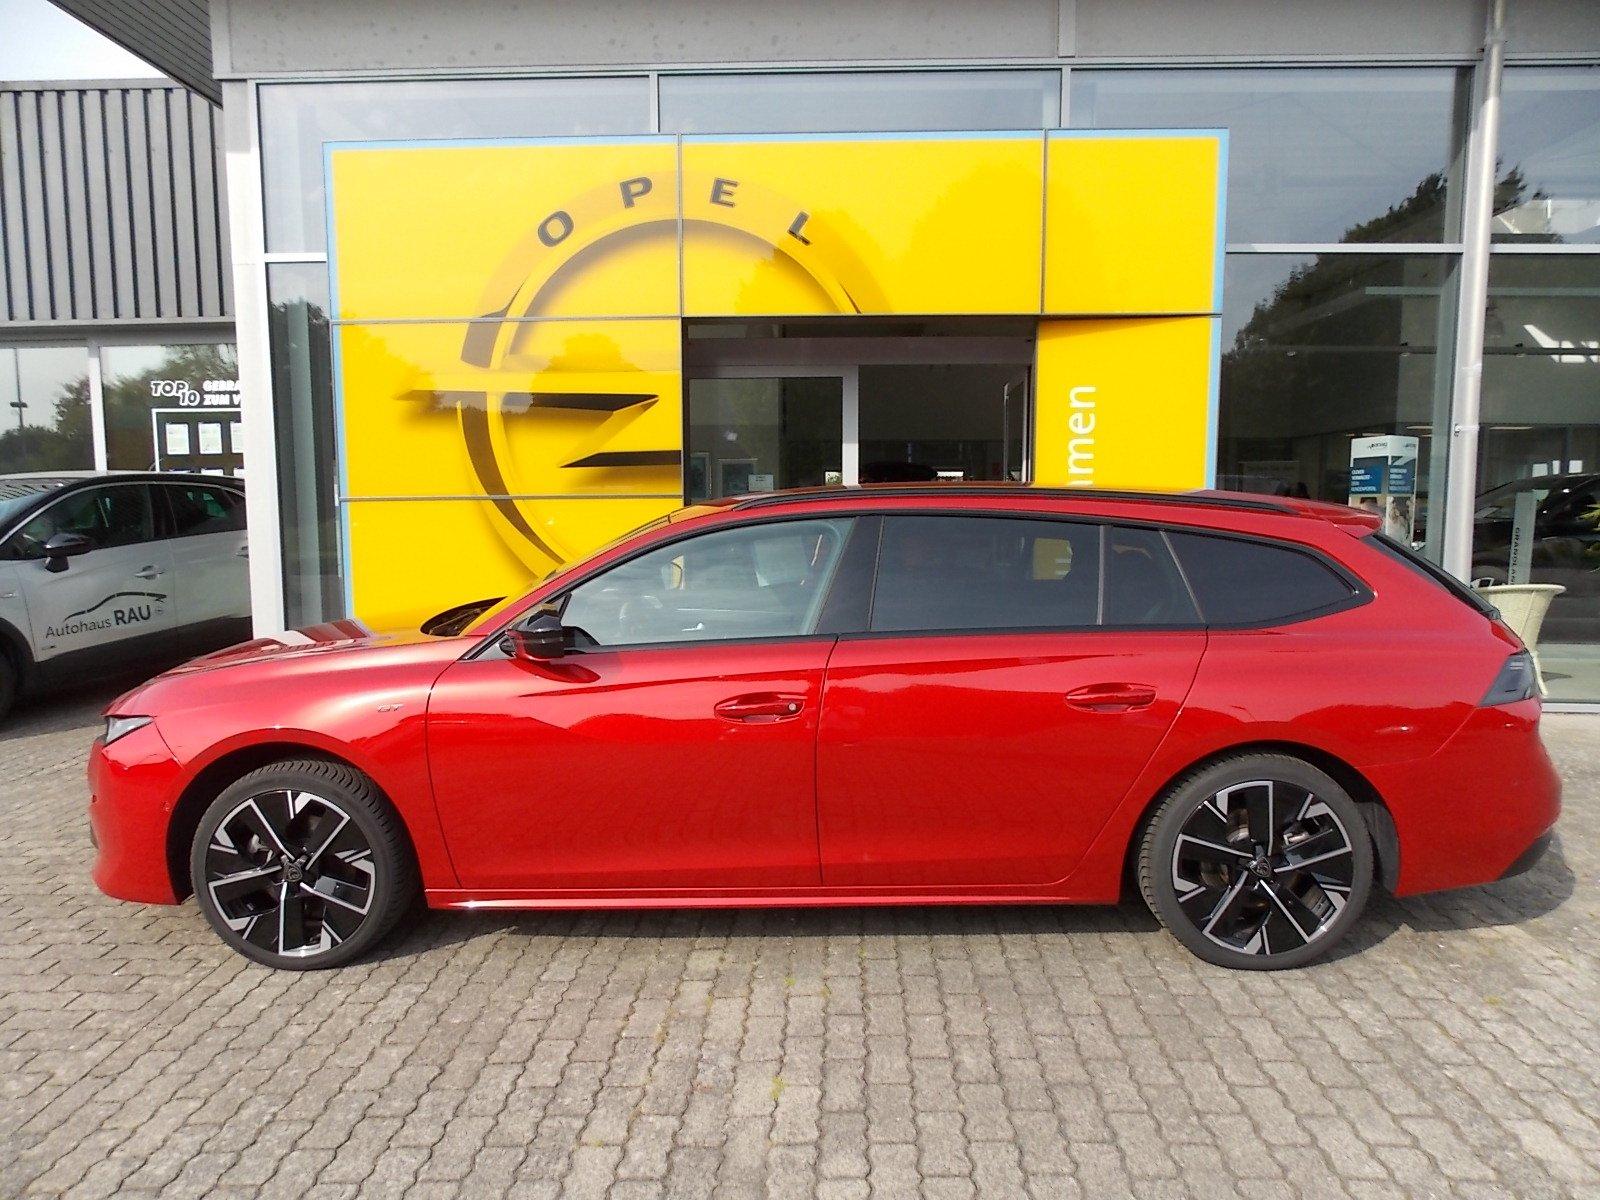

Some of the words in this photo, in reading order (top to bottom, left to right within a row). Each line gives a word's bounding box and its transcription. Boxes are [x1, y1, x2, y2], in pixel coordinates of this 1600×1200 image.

[537, 176, 813, 247] OPEL
[150, 380, 190, 397] TOP
[179, 389, 201, 407] 10
[203, 394, 230, 405] ZUM
[1067, 385, 1097, 486] men
[1510, 527, 1521, 585] GRANDLAN
[45, 618, 112, 639] Autohaus
[113, 604, 151, 626] RAU
